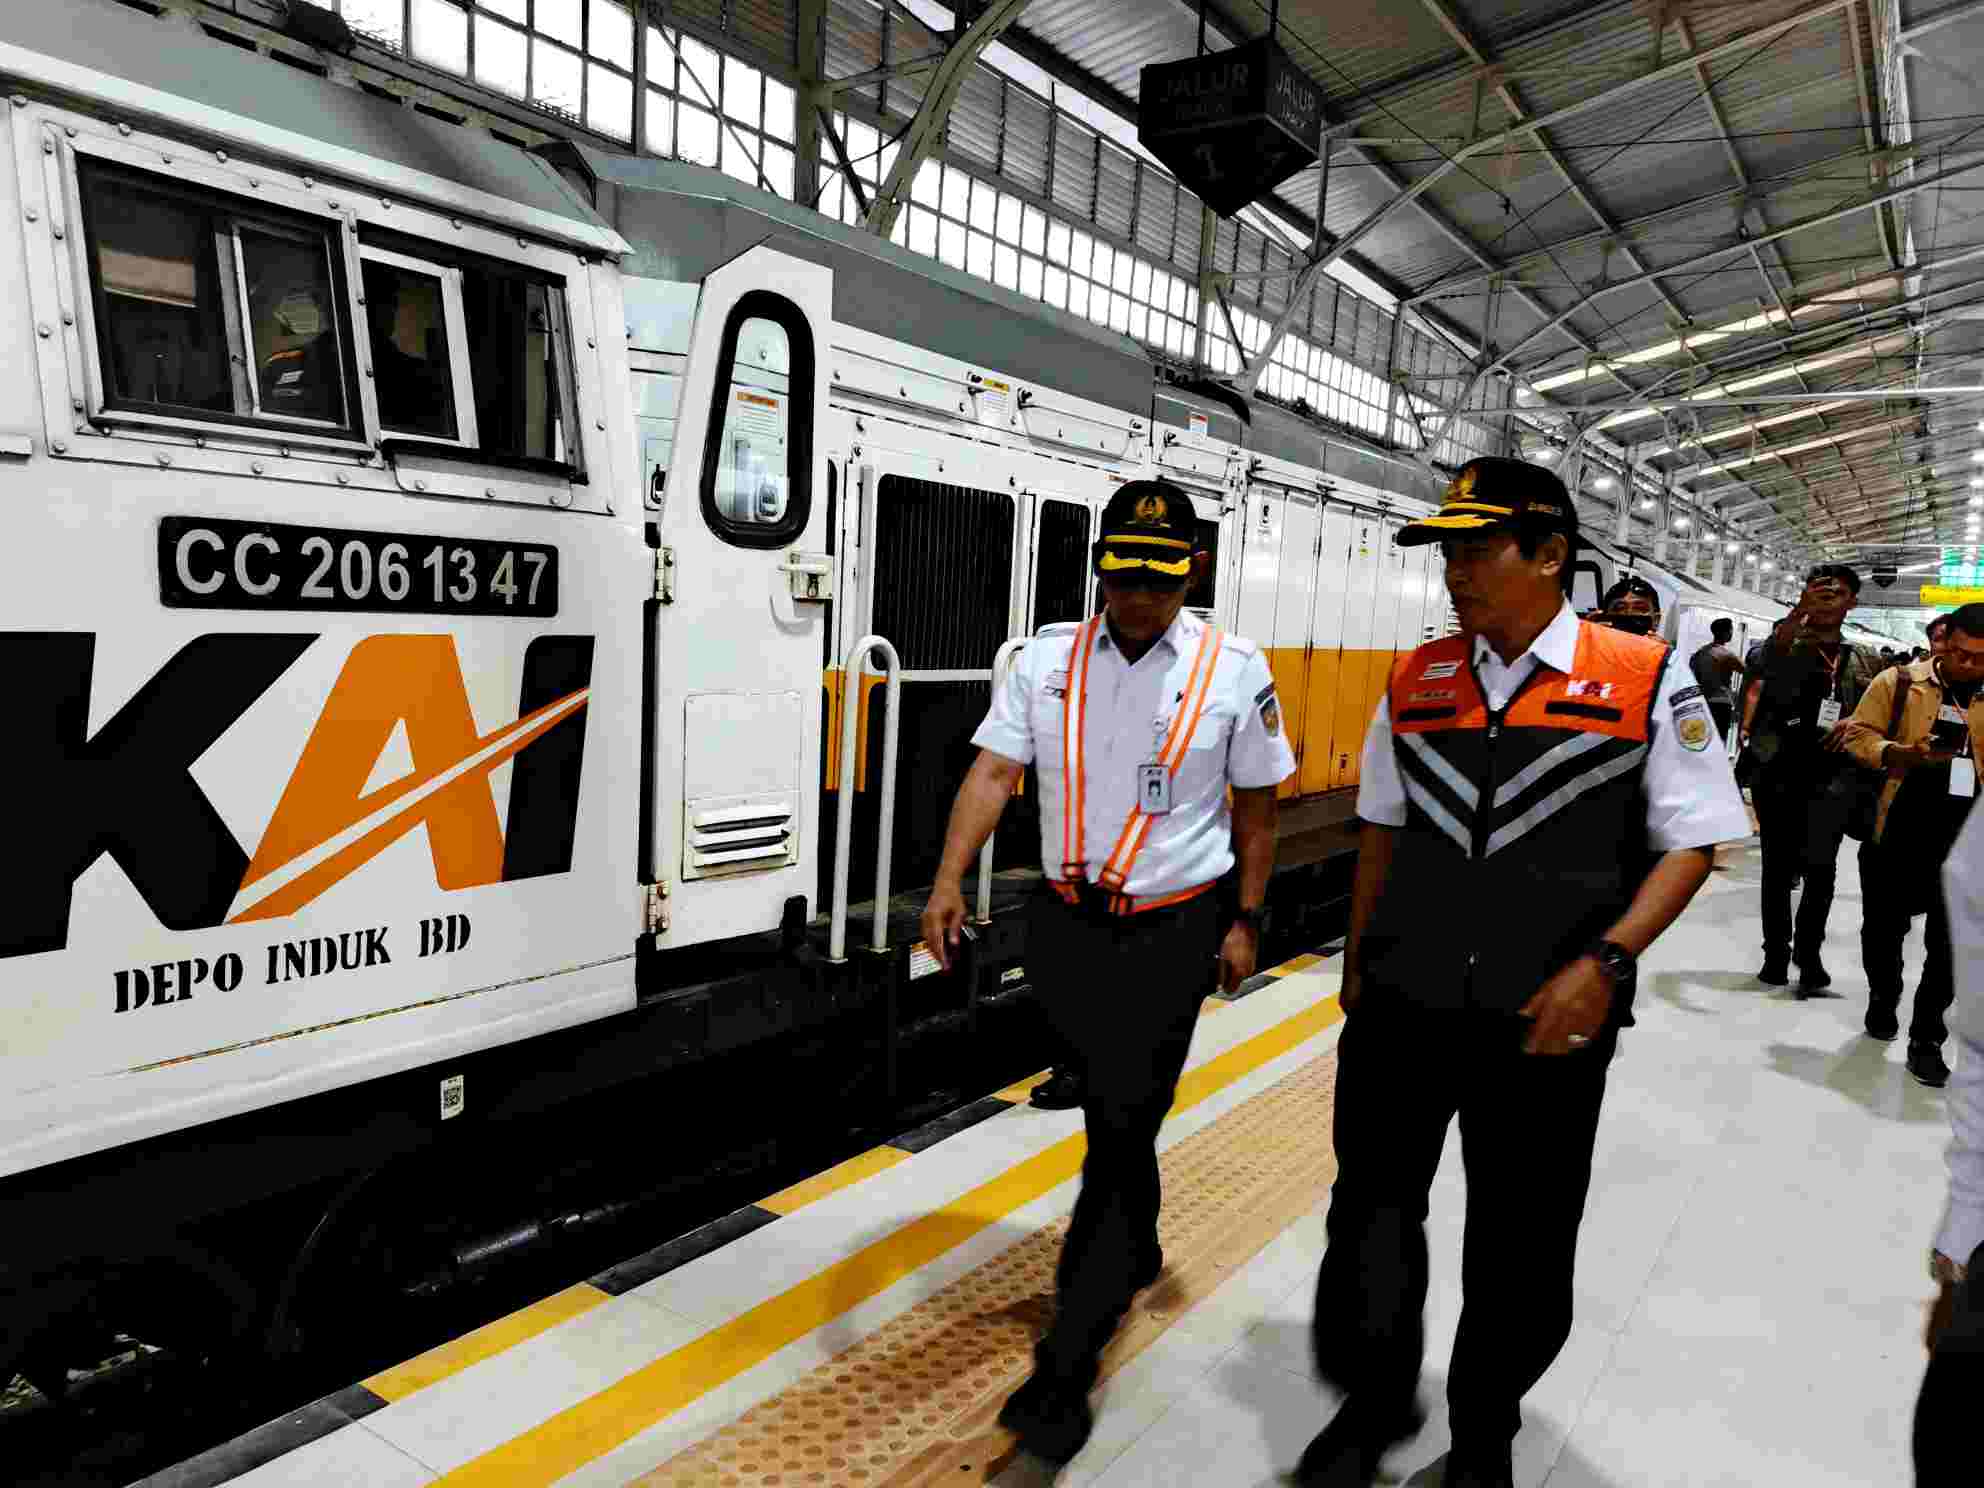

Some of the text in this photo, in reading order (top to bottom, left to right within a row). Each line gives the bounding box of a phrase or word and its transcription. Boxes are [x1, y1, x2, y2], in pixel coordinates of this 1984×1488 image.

[175, 528, 549, 606] CC 206 13 47
[0, 631, 596, 959] KAI
[113, 913, 472, 1015] DEPO INDUK BD
